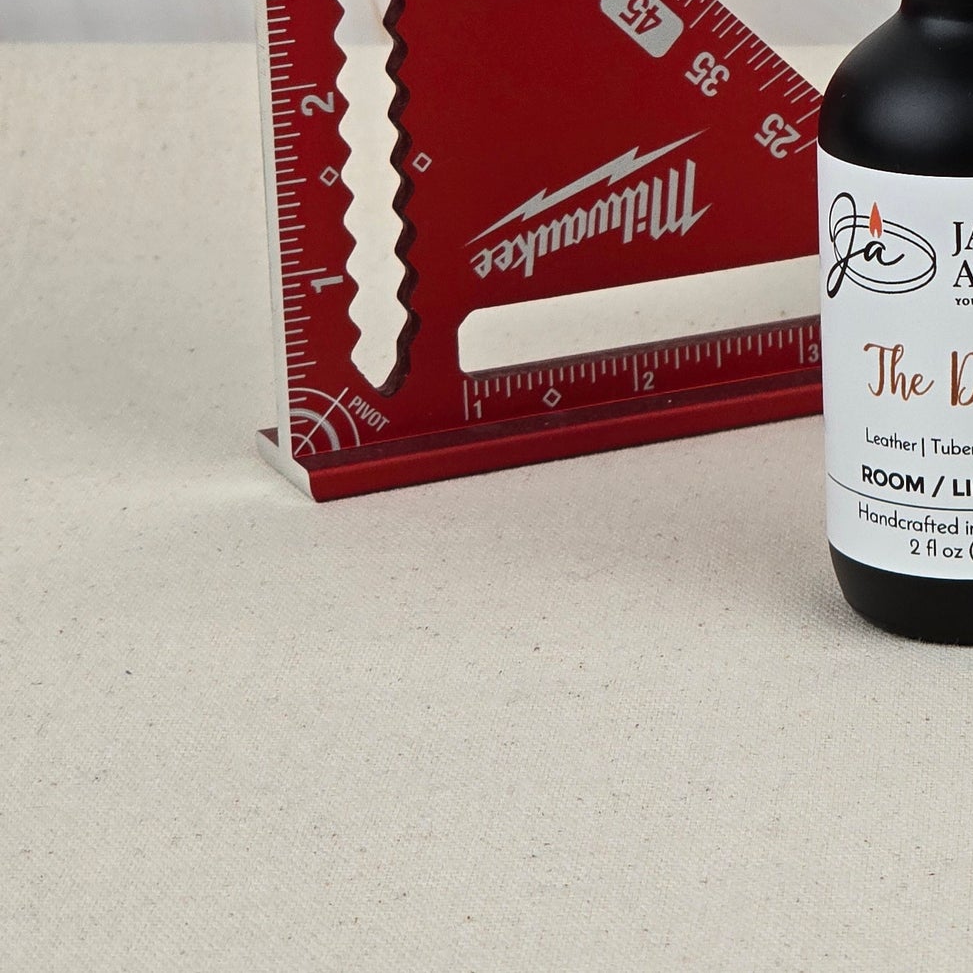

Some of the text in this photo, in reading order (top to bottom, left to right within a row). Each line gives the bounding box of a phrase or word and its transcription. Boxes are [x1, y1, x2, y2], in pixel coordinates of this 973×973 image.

[684, 51, 730, 97] 35
[301, 91, 335, 116] 2
[754, 113, 801, 159] 25
[469, 158, 712, 279] Milwaukee
[310, 275, 343, 294] 1
[808, 343, 819, 363] 3
[643, 371, 655, 391] 2
[863, 343, 934, 401] The
[348, 395, 390, 432] PIVOT
[473, 399, 482, 419] 1
[865, 427, 917, 452] Leather
[861, 464, 925, 494] ROOM
[858, 502, 959, 535] Handcrafted
[909, 539, 921, 556] 2
[926, 538, 937, 557] fl
[942, 546, 963, 559] oz
